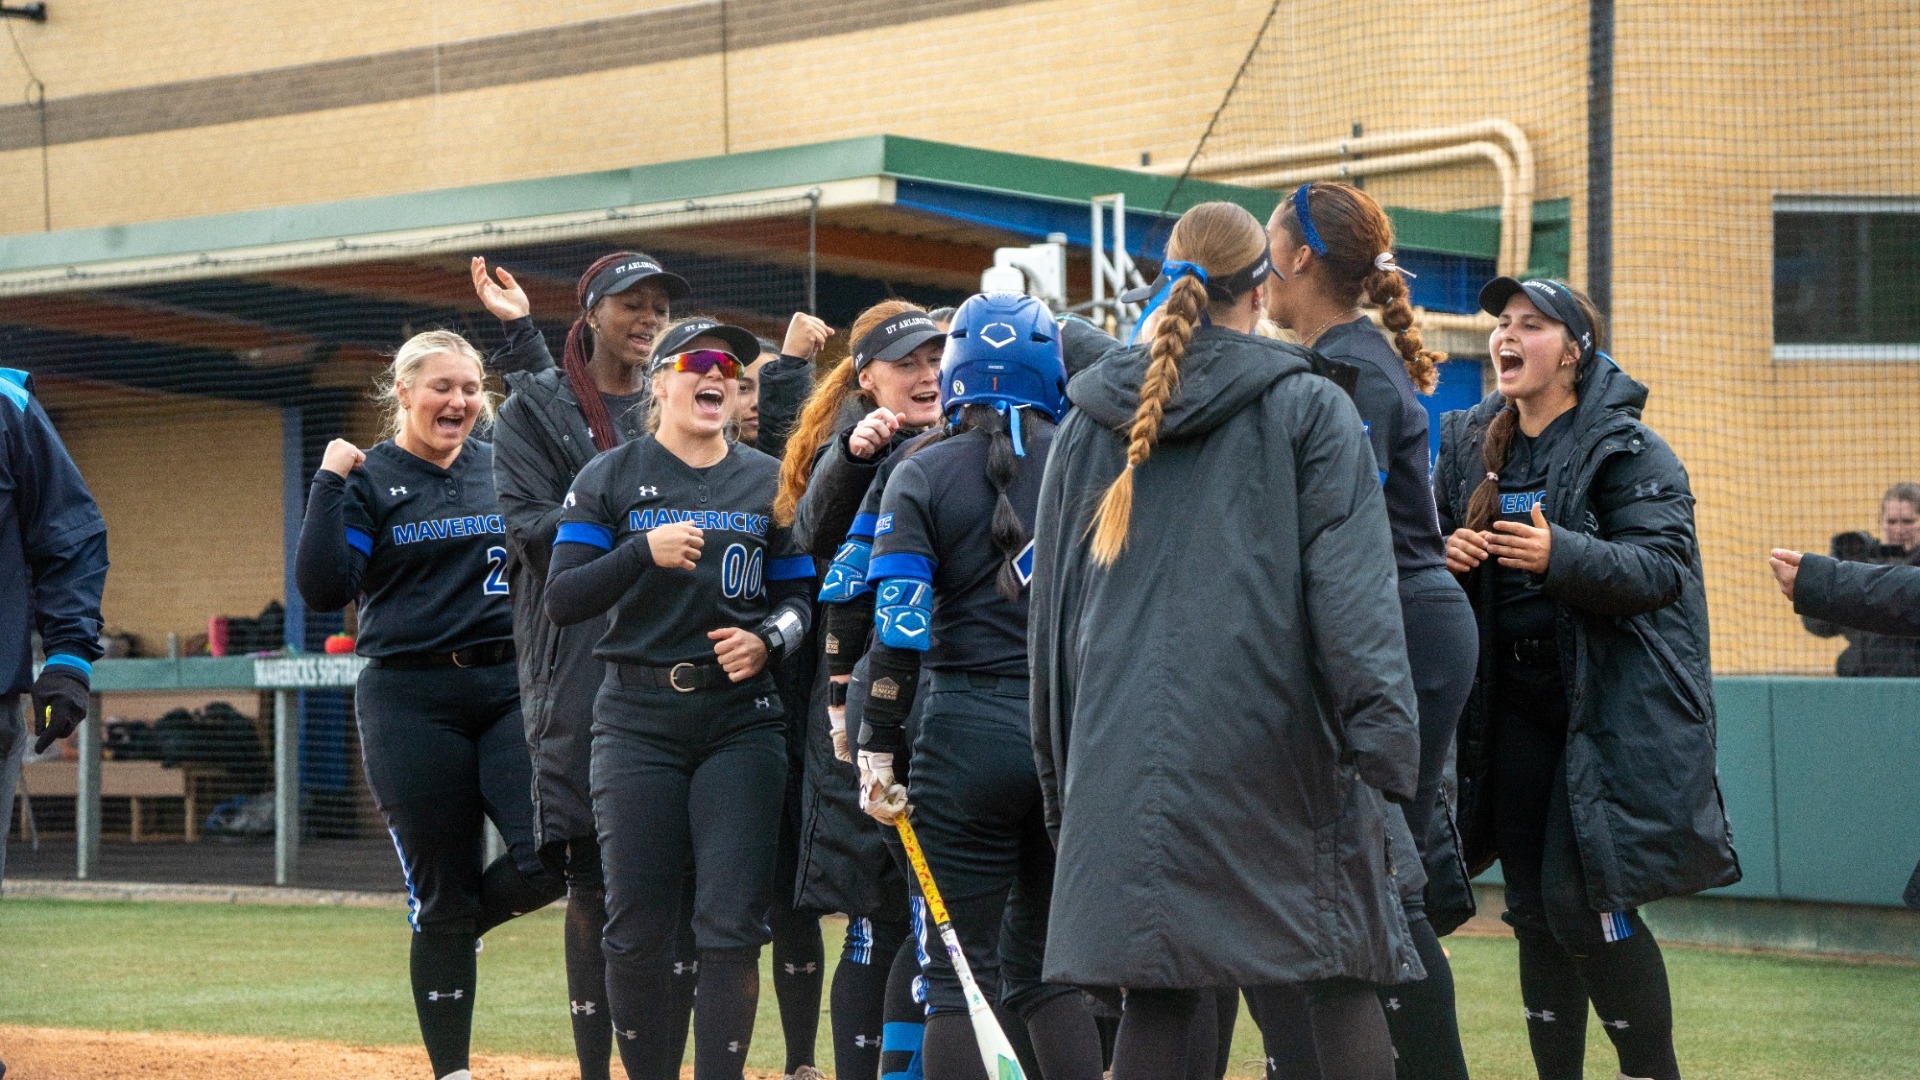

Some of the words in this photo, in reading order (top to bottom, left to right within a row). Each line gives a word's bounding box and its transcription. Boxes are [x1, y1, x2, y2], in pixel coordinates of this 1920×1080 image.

[615, 265, 626, 274] UT
[885, 324, 897, 334] UT
[393, 514, 506, 545] MAVERIC
[629, 508, 768, 536] MAVERICKS
[722, 543, 762, 600] 00
[254, 658, 317, 686] MAVERICKS
[318, 656, 371, 686] SOFTB
